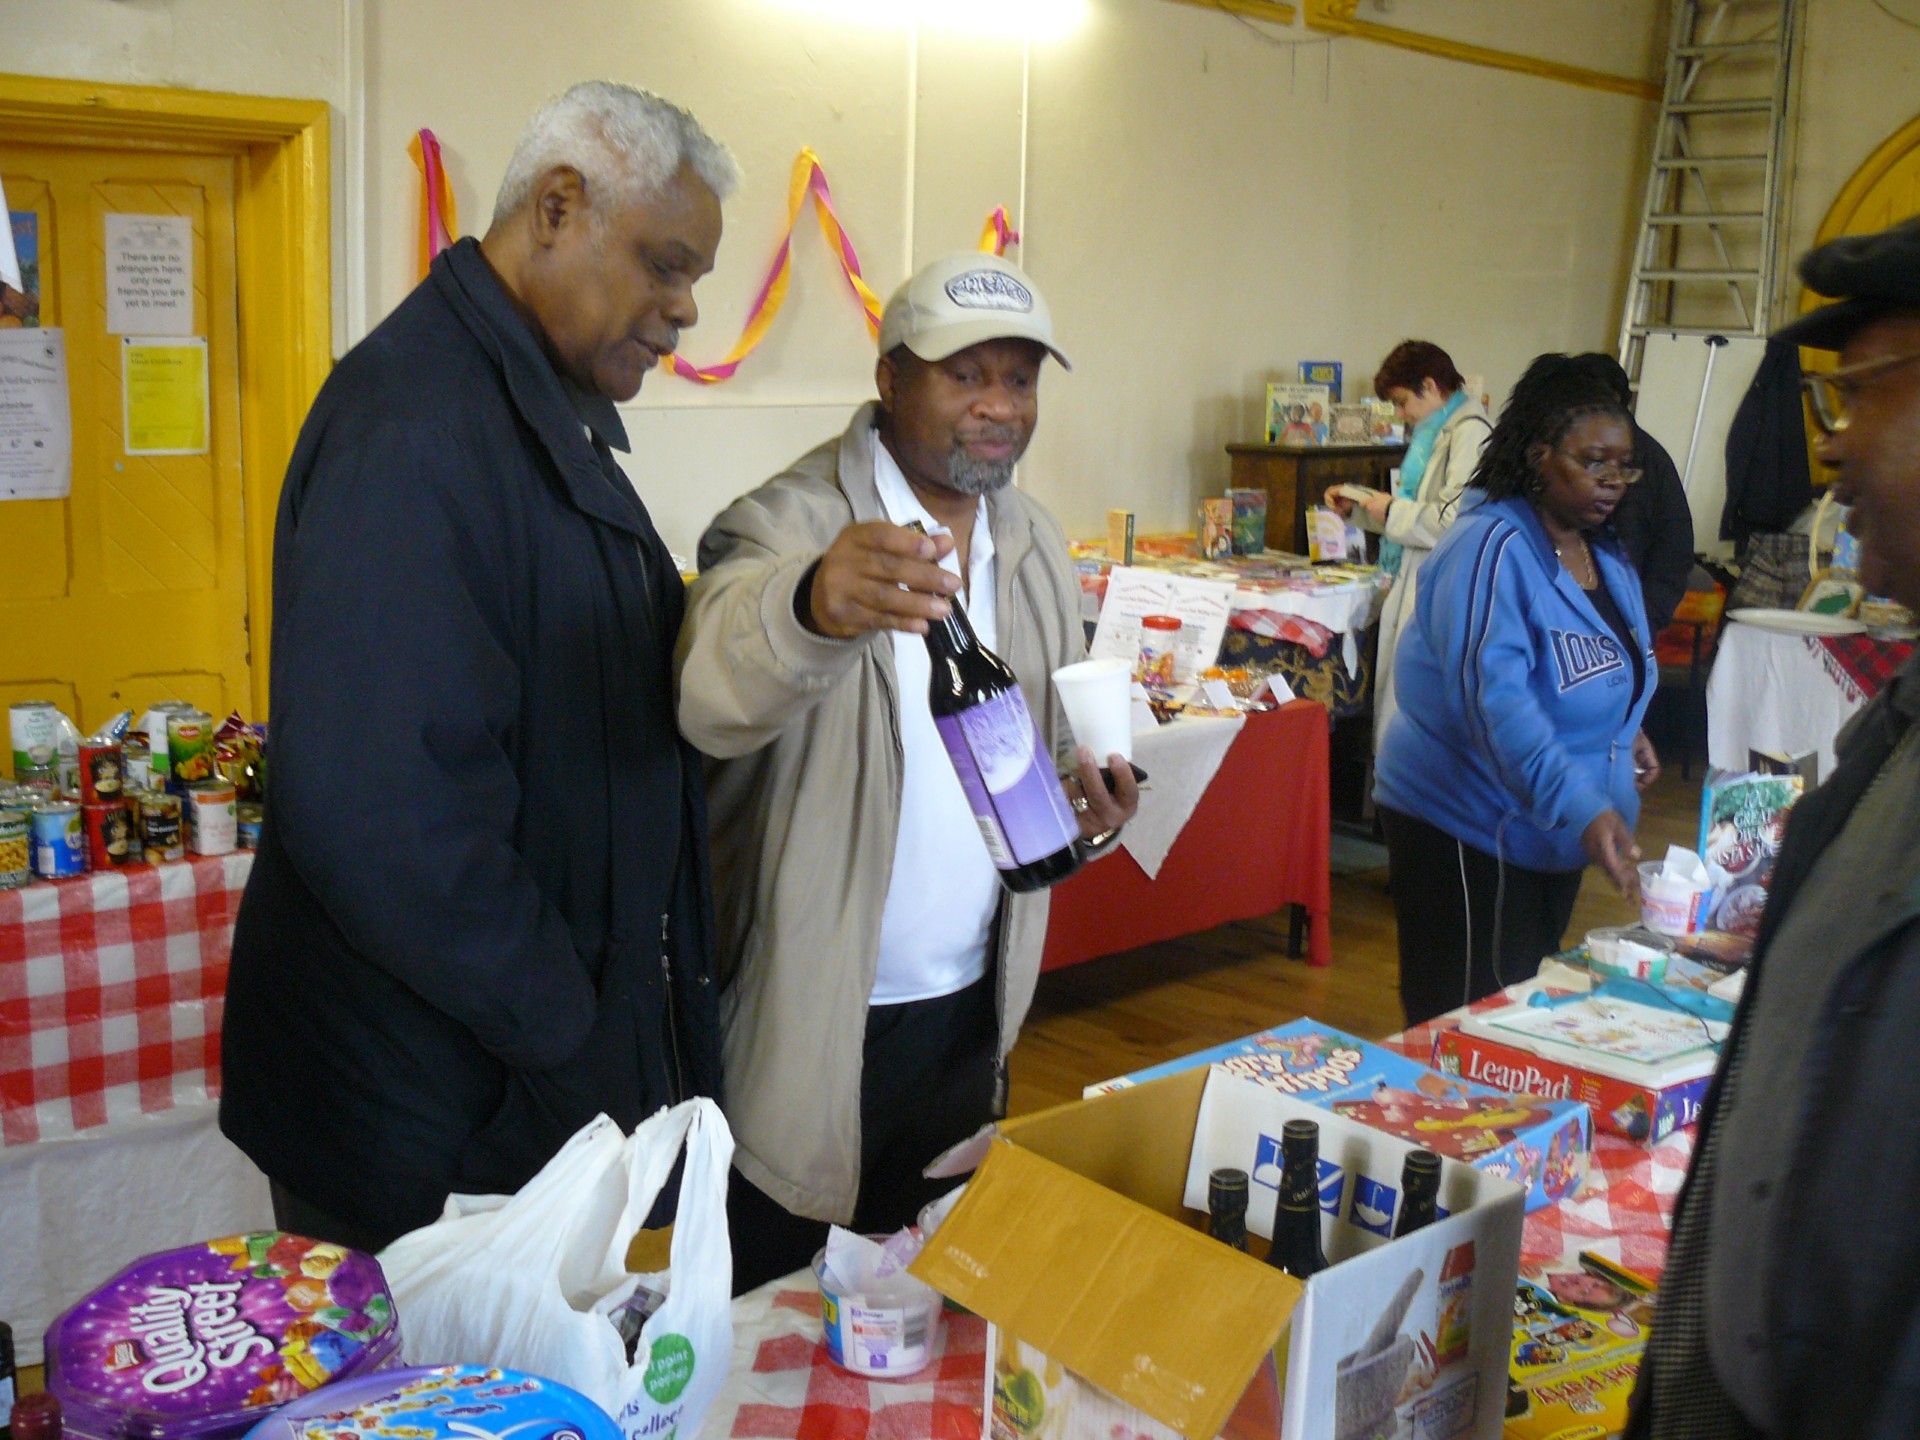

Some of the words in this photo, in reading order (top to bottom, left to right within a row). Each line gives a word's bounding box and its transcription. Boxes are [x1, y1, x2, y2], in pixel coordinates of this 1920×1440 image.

[116, 265, 160, 275] strangers
[122, 252, 149, 262] There
[1467, 1048, 1572, 1100] LeapPad
[129, 1285, 208, 1394] Quality
[190, 1280, 275, 1368] Street
